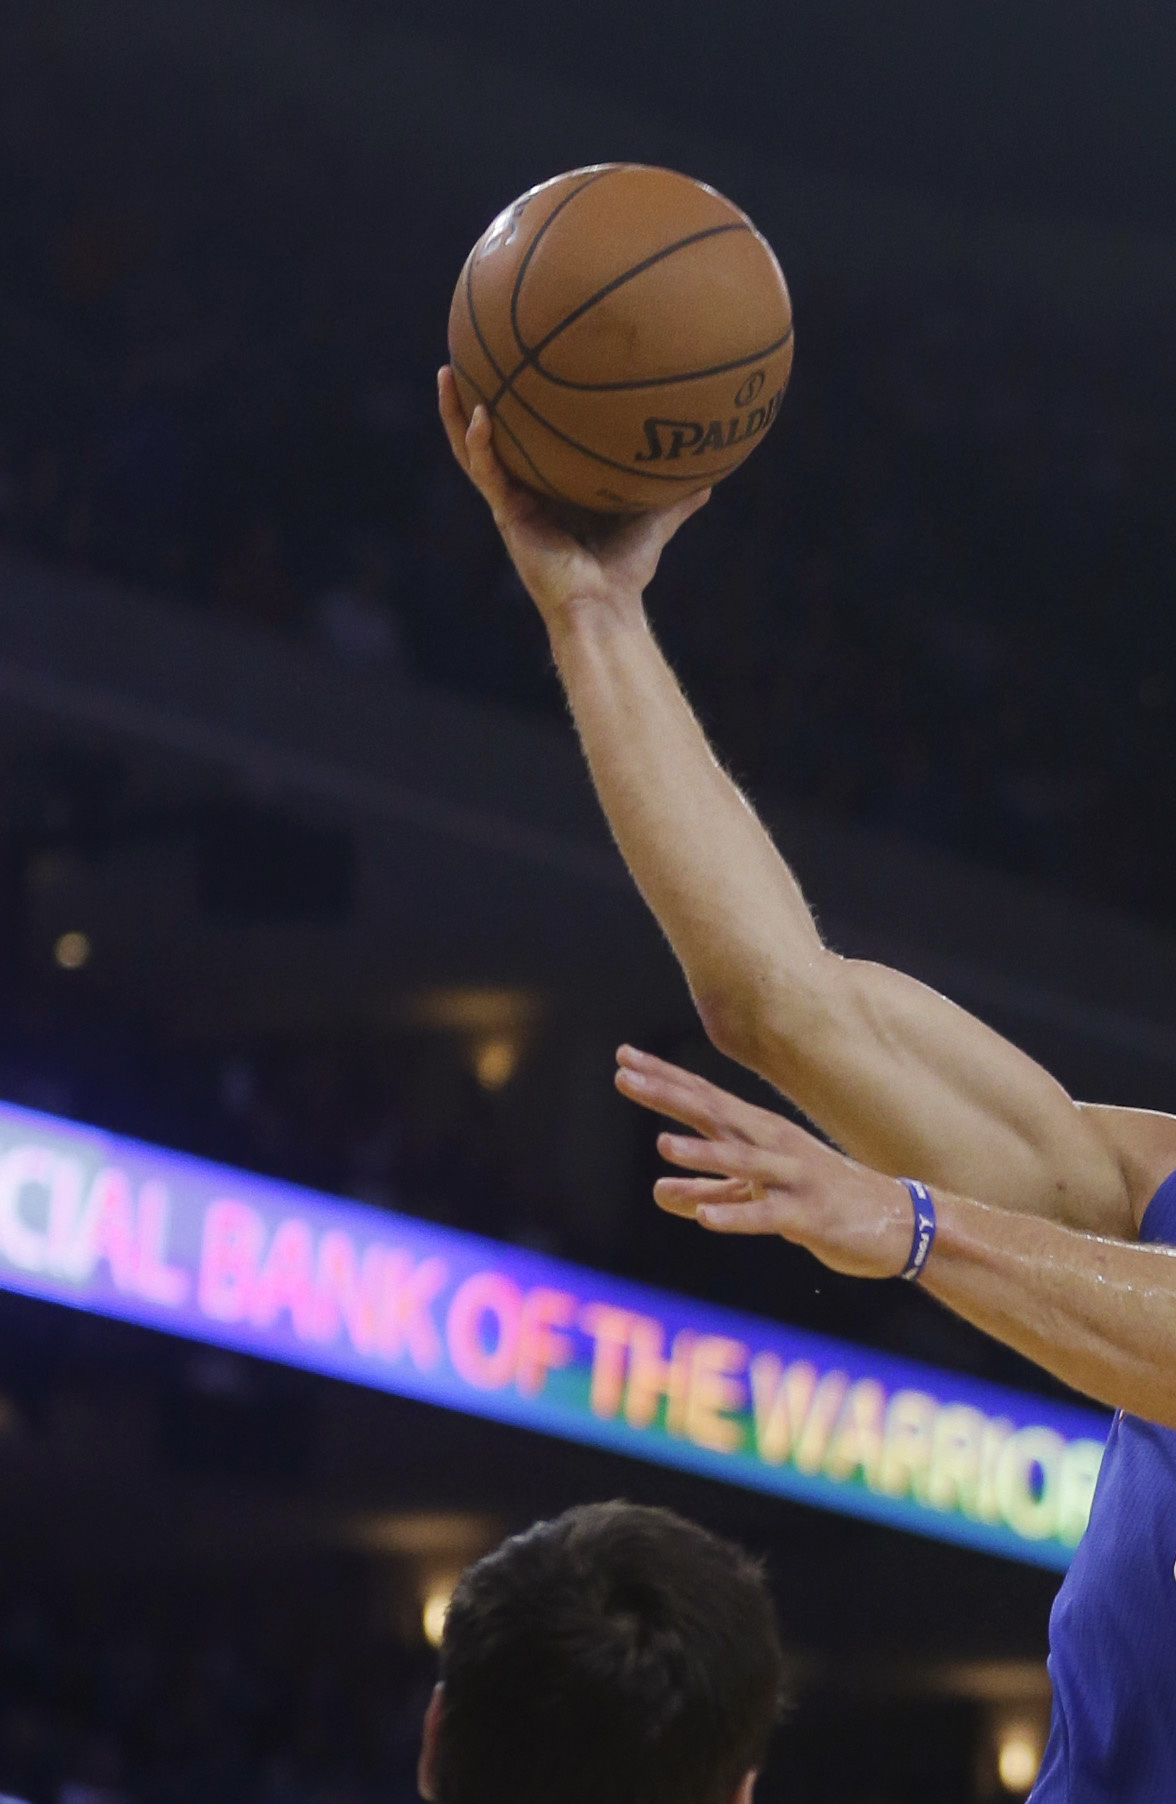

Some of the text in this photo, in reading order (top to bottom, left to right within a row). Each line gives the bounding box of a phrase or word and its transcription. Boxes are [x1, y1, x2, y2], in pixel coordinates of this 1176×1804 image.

[200, 1198, 448, 1373] BANK
[445, 1270, 578, 1397] OF
[578, 1302, 750, 1454] THE
